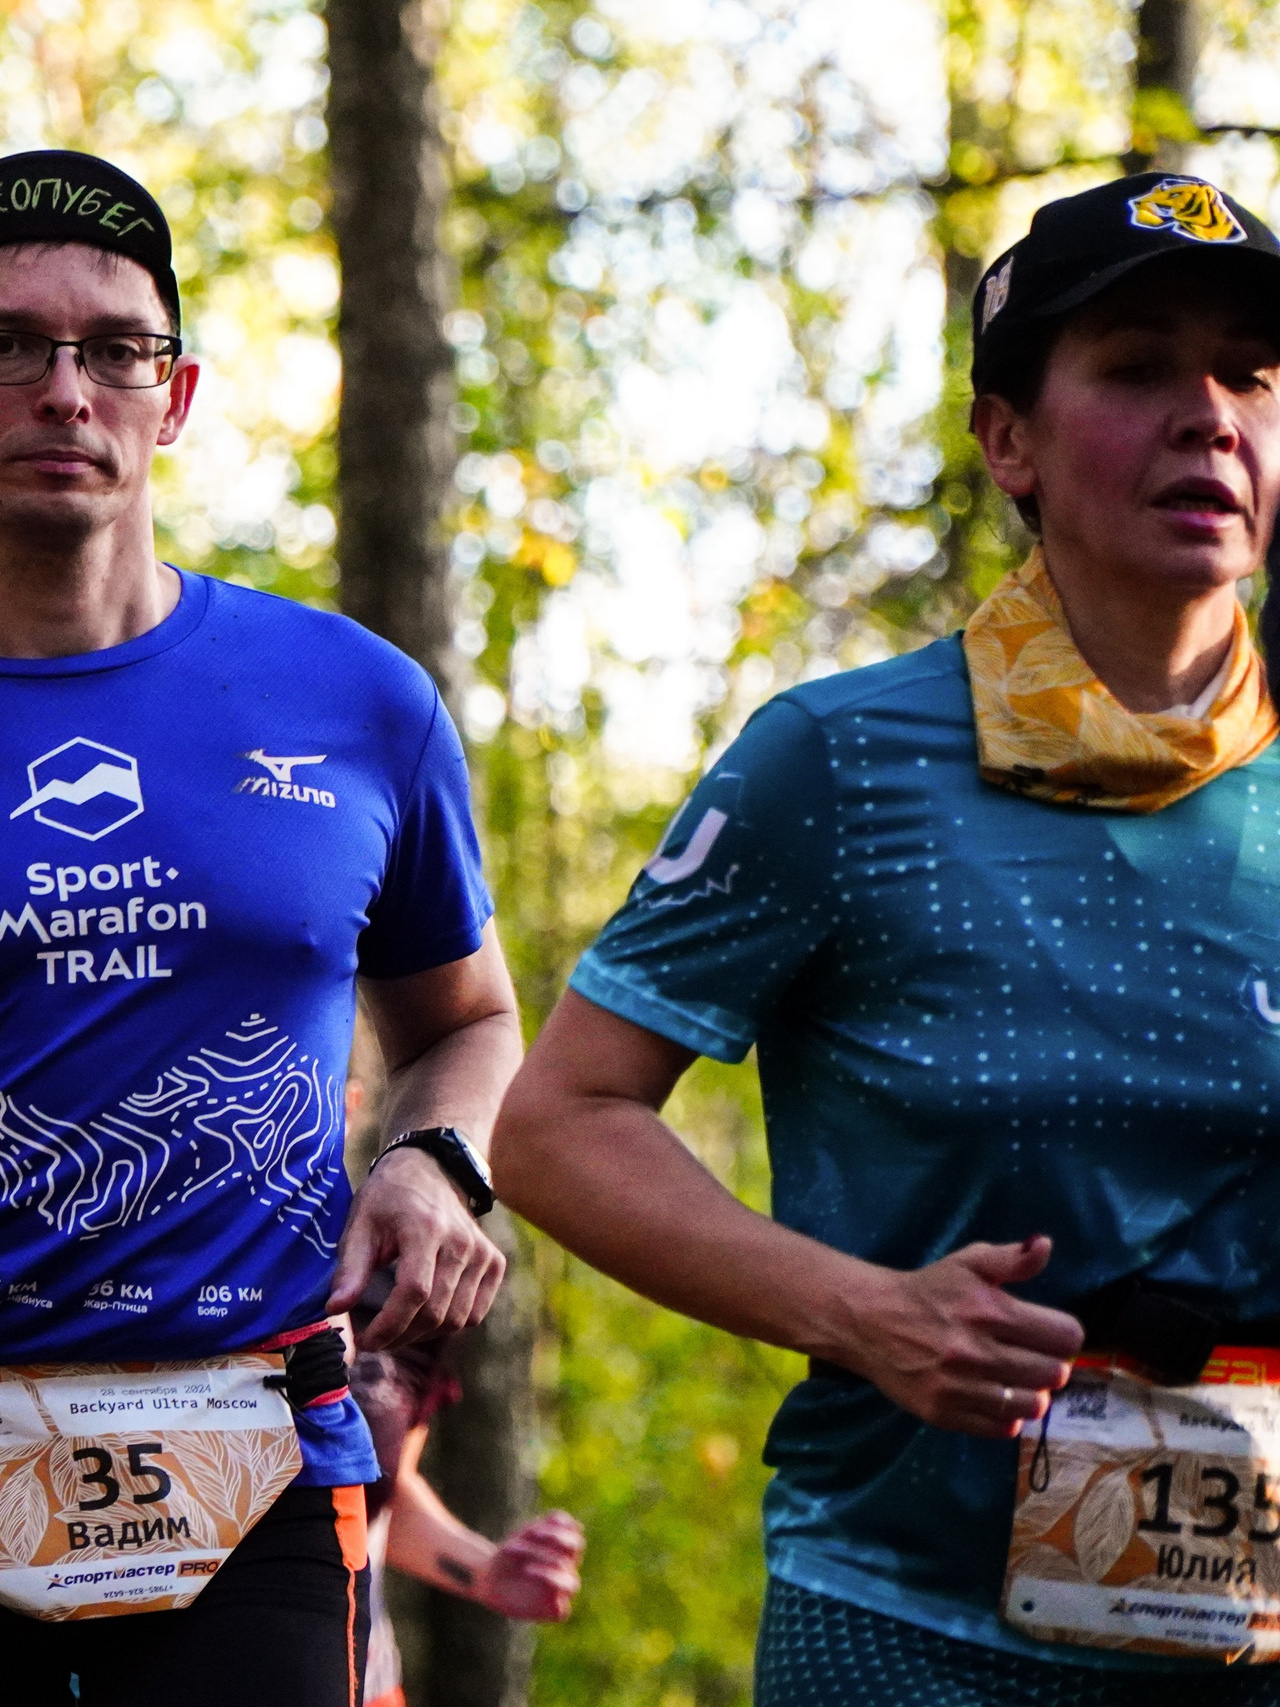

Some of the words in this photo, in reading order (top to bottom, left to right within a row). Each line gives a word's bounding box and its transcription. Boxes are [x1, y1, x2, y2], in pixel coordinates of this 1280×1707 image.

[36, 944, 173, 985] TRAIL
[197, 1284, 233, 1303] 106
[183, 1384, 212, 1394] 2024
[70, 1399, 144, 1415] Backyard
[153, 1398, 198, 1410] Ultra
[206, 1398, 257, 1409] Moscow
[72, 1443, 172, 1511] 35
[67, 1517, 191, 1550] Вадим
[180, 1560, 219, 1575] PRO
[1157, 1544, 1256, 1584] Юлия
